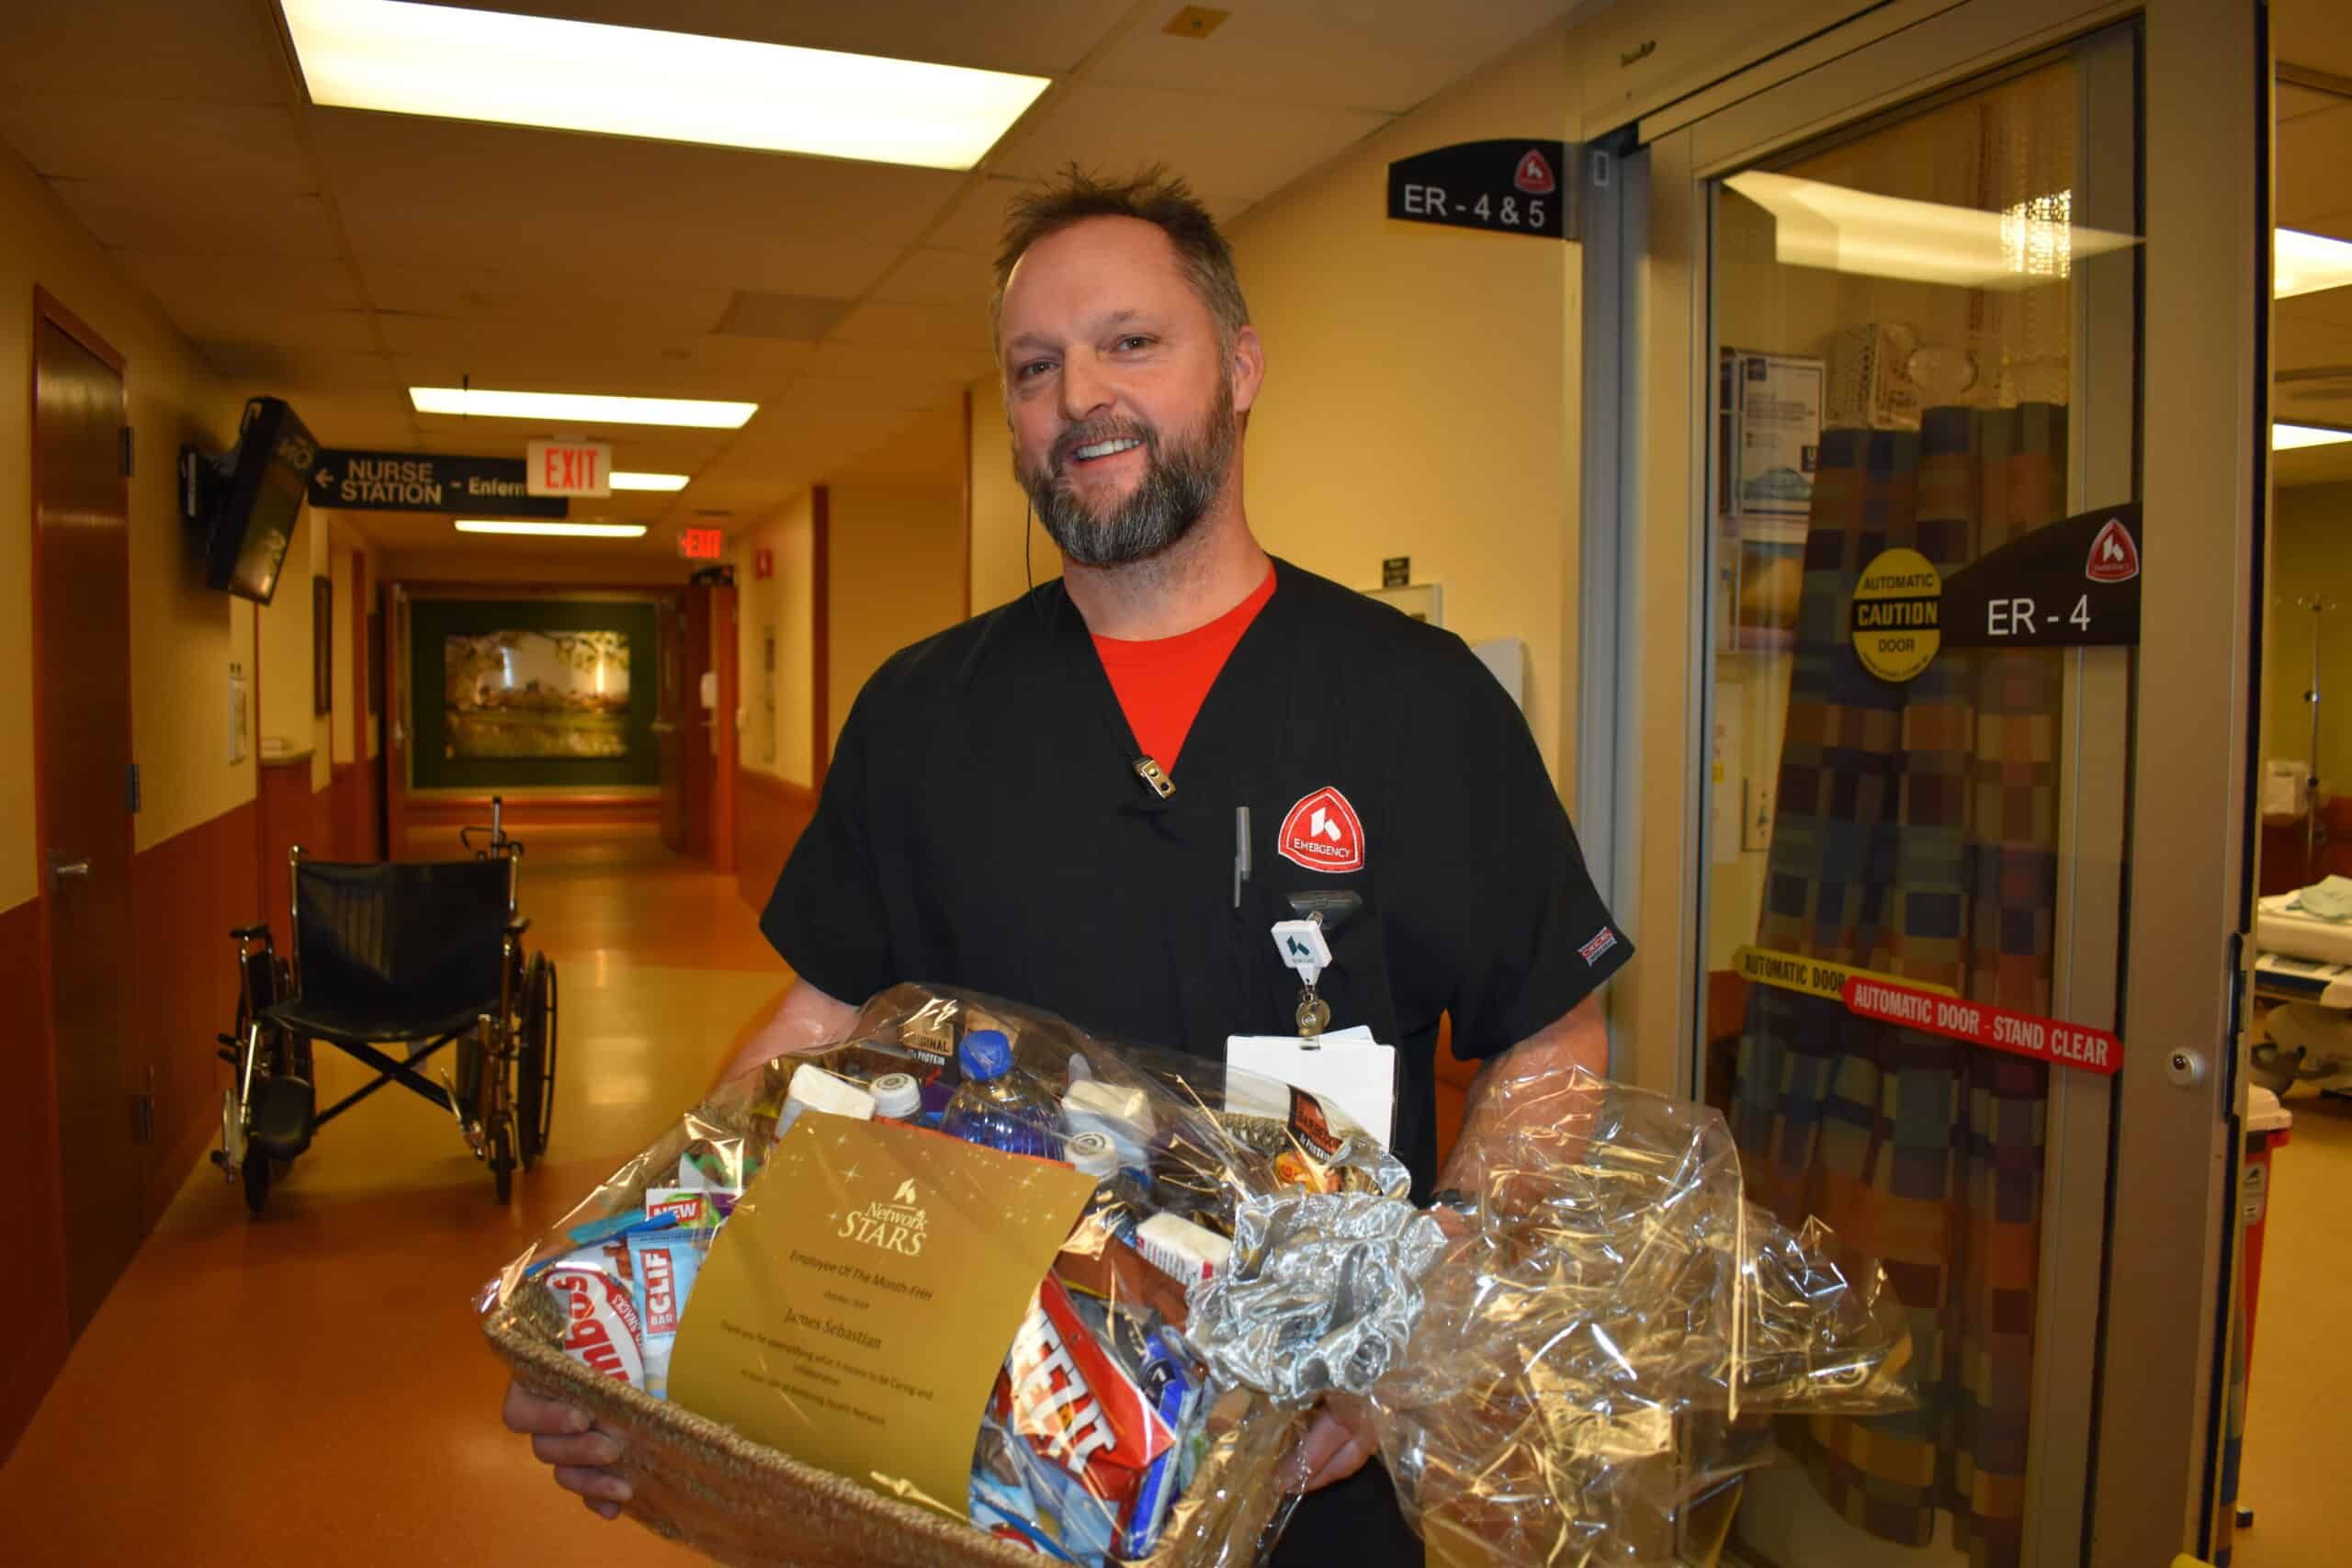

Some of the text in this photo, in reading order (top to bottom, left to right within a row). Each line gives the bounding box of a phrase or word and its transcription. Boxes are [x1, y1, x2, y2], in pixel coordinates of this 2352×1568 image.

[1405, 184, 1448, 216] ER
[1474, 193, 1491, 220] 4
[1499, 196, 1520, 225] &
[1529, 200, 1544, 228] 5
[348, 458, 435, 483] NURSE
[544, 447, 598, 490] EXIT
[341, 481, 443, 504] STATION
[687, 529, 721, 558] EXIT
[1863, 573, 1934, 591] AUTOMATIC
[1858, 602, 1938, 626] CAUTION
[1987, 598, 2037, 636] ER
[2069, 594, 2091, 632] 4
[1878, 638, 1916, 653] DOOR
[1294, 838, 1351, 858] EMERGENCY
[1746, 954, 1807, 986] AUTOMATIC
[1853, 985, 1932, 1024] AUTOMATIC
[1937, 1004, 1980, 1034] DOOR
[1994, 1016, 2045, 1050] STAND
[2051, 1028, 2108, 1066] CLEAR
[865, 1201, 929, 1231] Network
[838, 1211, 927, 1257] STARS
[788, 1249, 838, 1272] Employee
[854, 1269, 872, 1284] The
[646, 1251, 671, 1314] CLIF
[650, 1314, 673, 1325] BAR
[784, 1307, 881, 1349] James Sebastian
